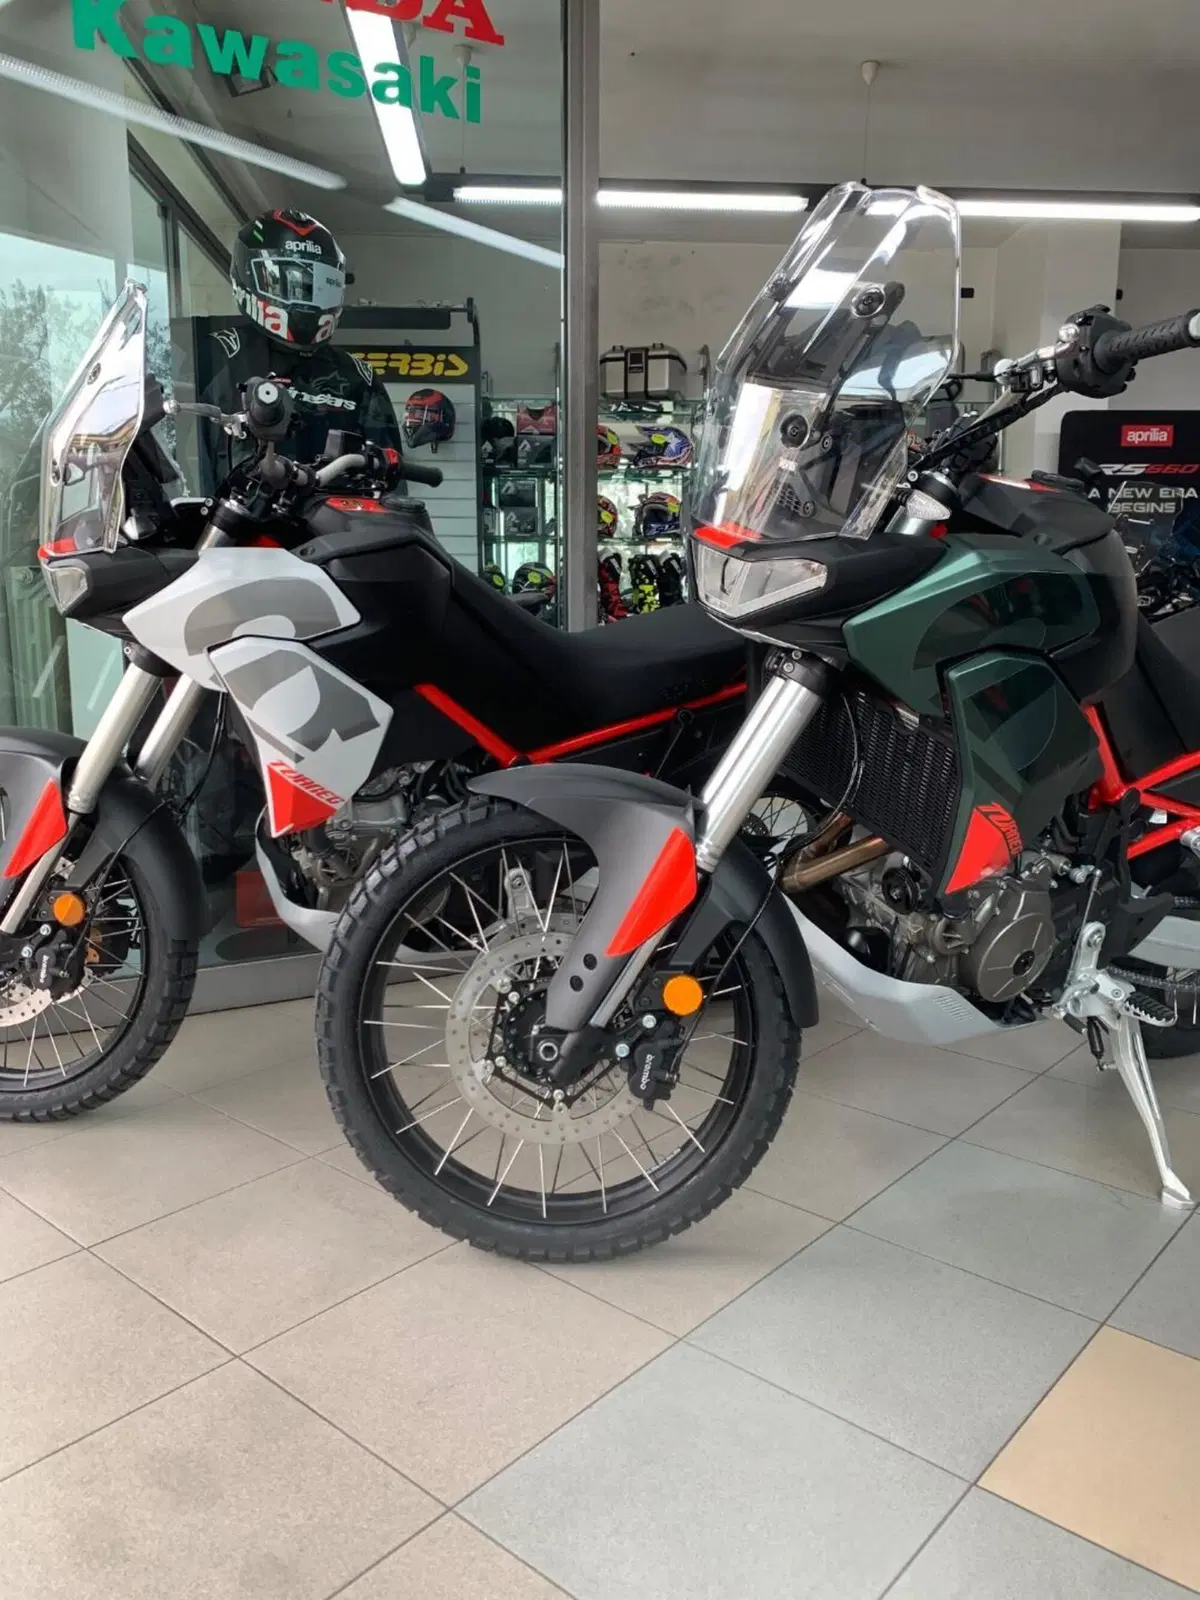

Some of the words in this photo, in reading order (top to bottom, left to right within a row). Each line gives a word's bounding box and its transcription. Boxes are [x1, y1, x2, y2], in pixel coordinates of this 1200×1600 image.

[72, 0, 480, 123] Kawasaki
[285, 240, 322, 254] aprilia
[1127, 428, 1168, 444] aprilia
[1088, 488, 1101, 499] A
[1108, 488, 1153, 498] NEW
[1160, 488, 1198, 498] ERA
[1108, 502, 1176, 513] BEGINS
[640, 1053, 656, 1090] brembo
